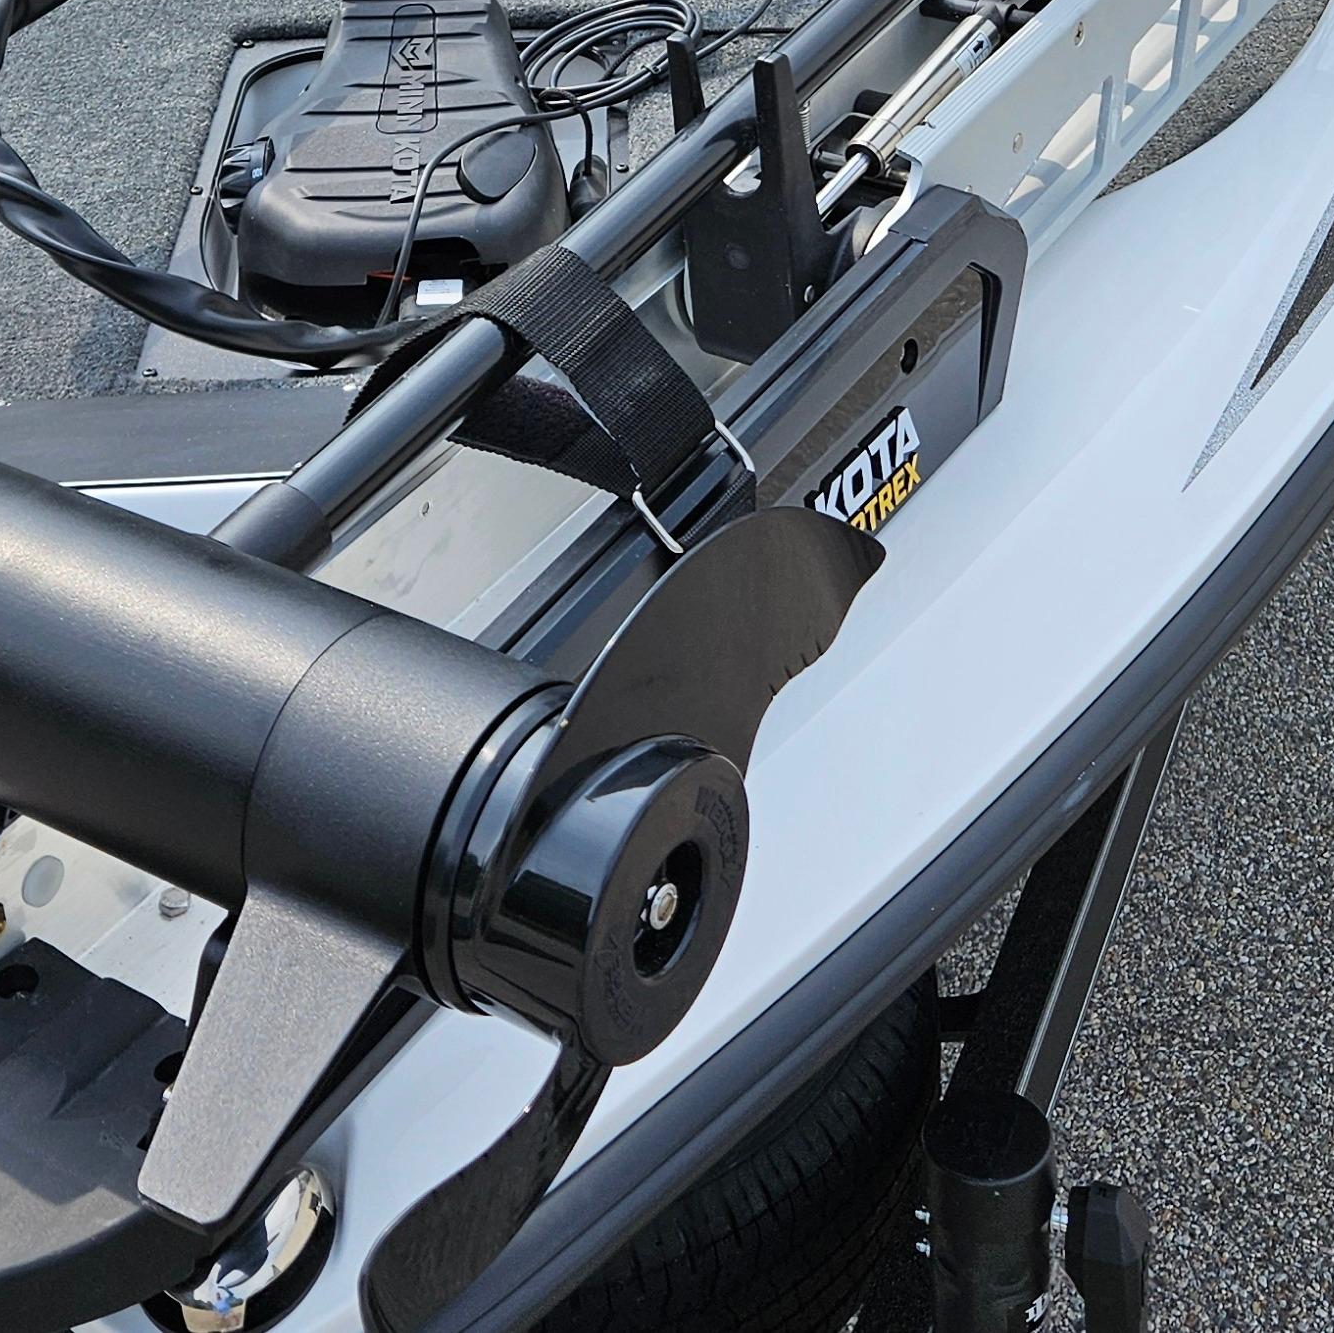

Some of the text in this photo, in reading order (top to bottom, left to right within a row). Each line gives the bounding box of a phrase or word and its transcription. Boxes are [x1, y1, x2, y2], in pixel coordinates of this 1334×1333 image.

[390, 72, 426, 205] MINN KOTA
[813, 407, 921, 523] KOTA
